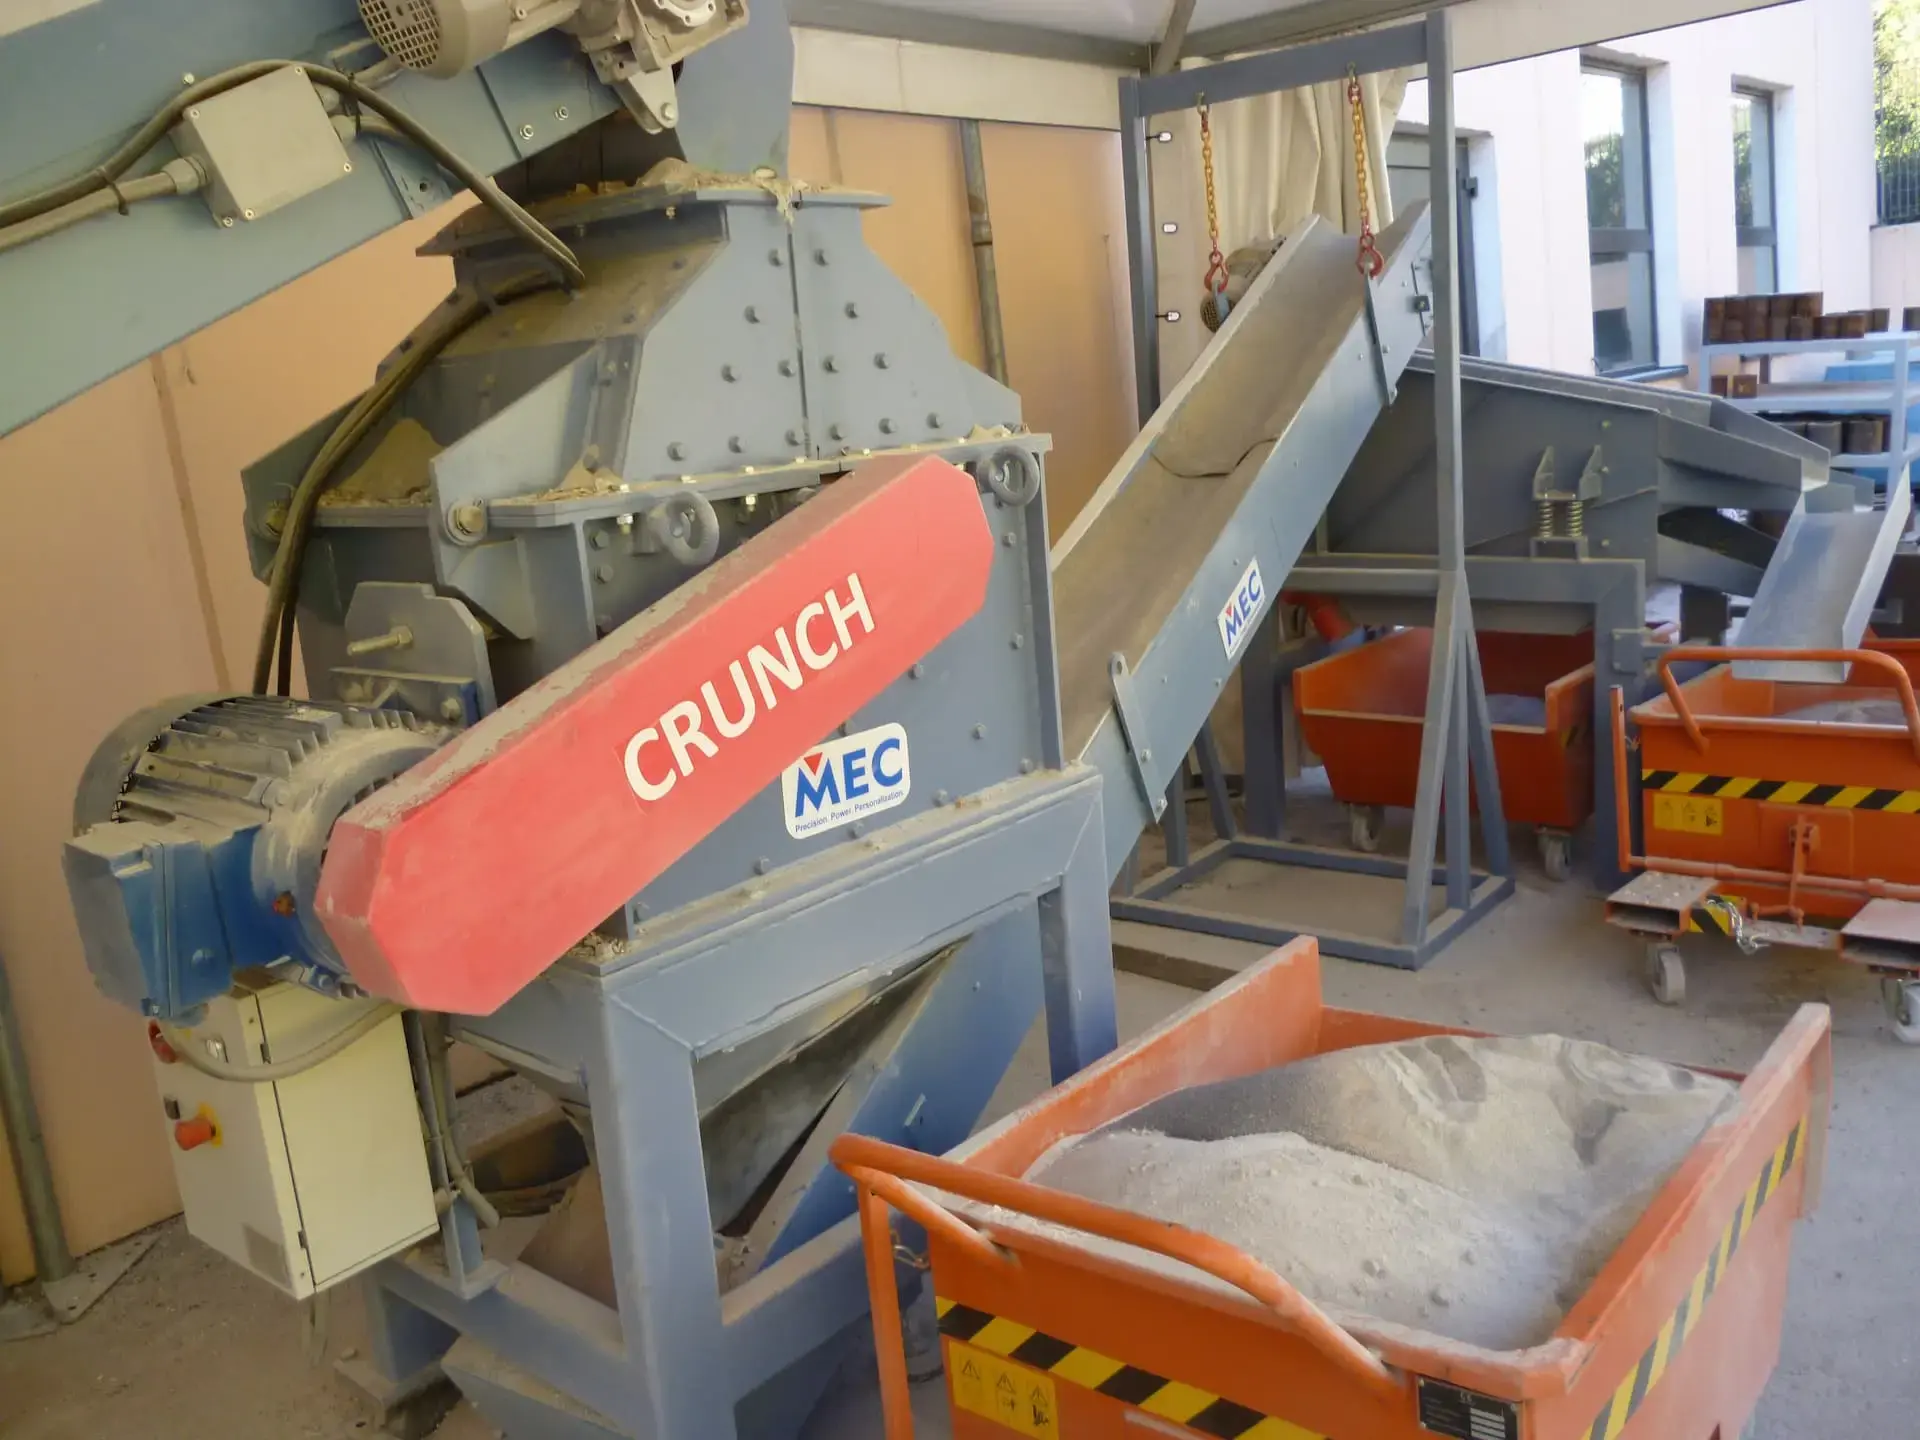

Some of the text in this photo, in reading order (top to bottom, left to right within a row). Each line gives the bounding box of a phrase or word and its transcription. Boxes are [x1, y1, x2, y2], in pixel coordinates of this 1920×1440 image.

[1225, 569, 1260, 645] MEC
[624, 573, 875, 801] CRUNCH
[795, 738, 903, 818] MEC
